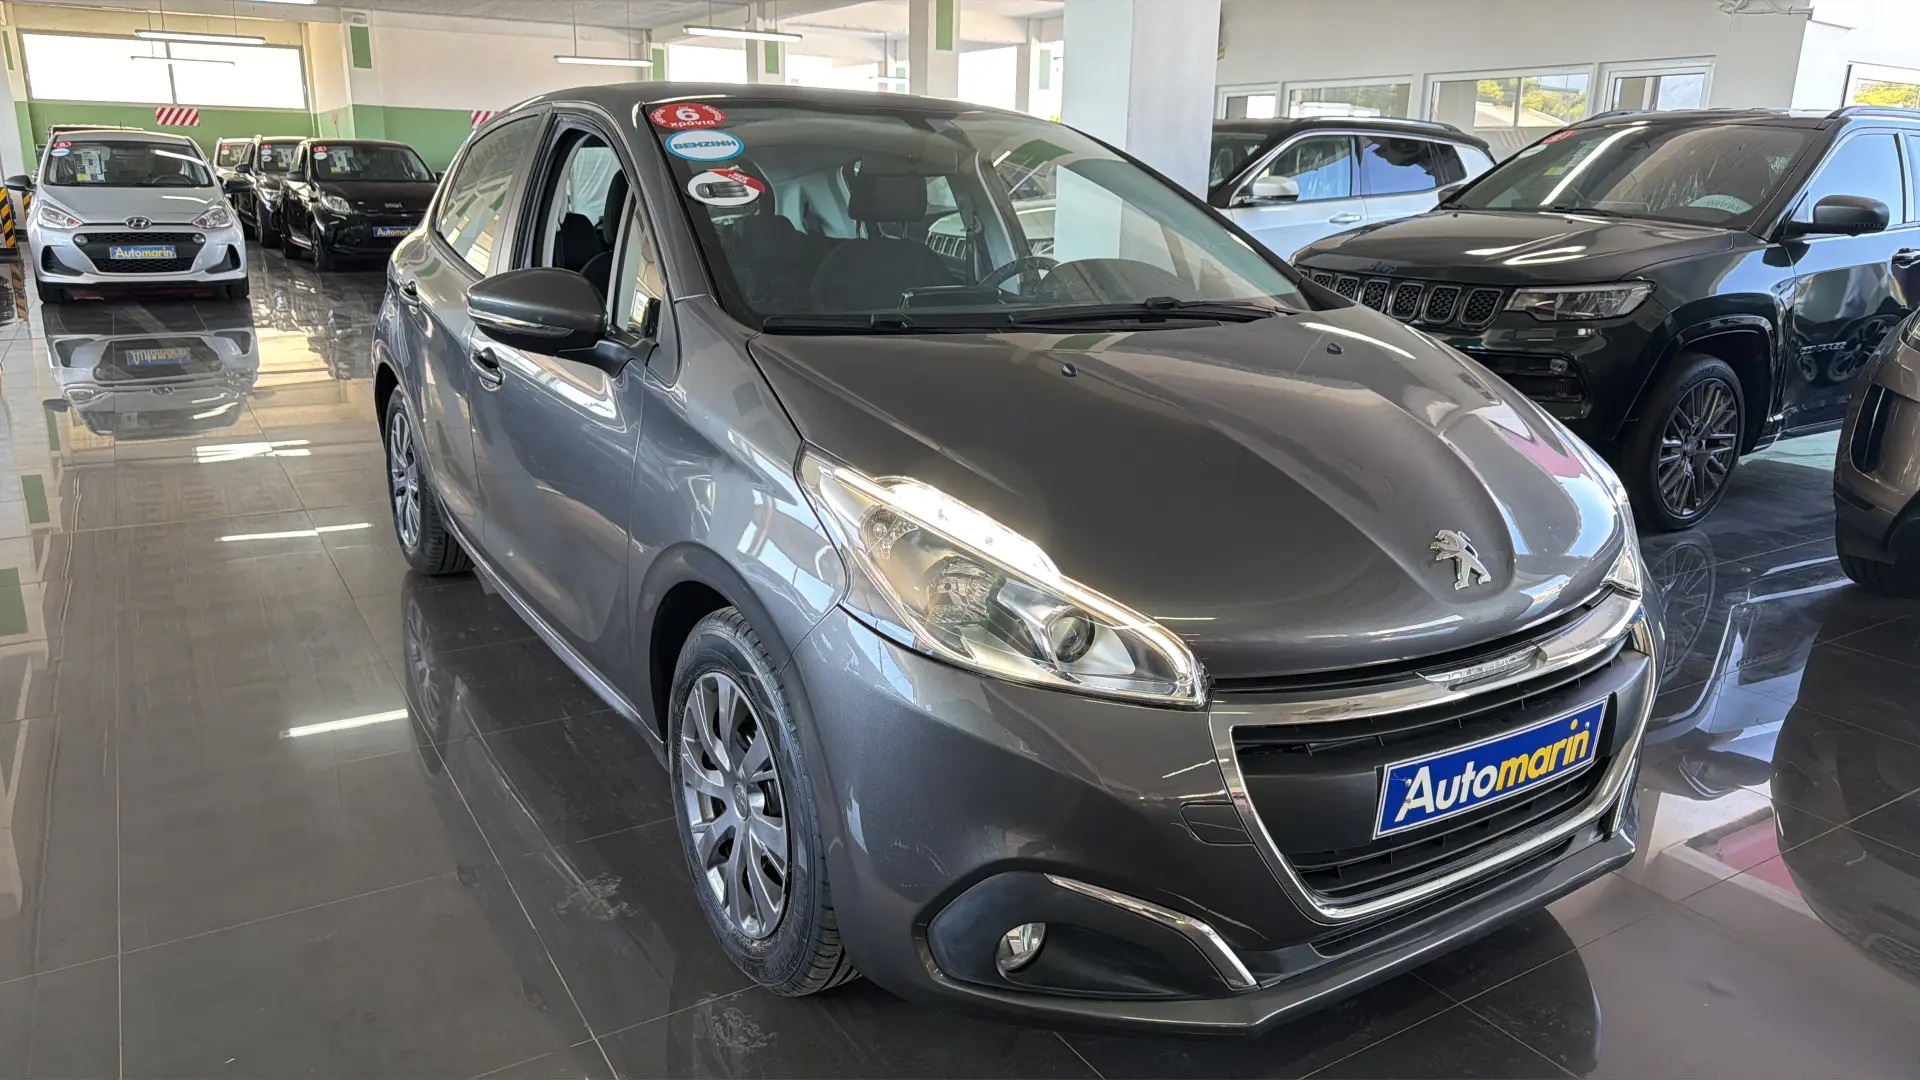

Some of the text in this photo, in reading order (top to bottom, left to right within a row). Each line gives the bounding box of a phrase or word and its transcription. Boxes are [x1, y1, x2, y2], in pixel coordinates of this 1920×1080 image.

[675, 107, 700, 121] 6
[115, 246, 174, 258] Automarin
[1394, 719, 1590, 822] Automarin
